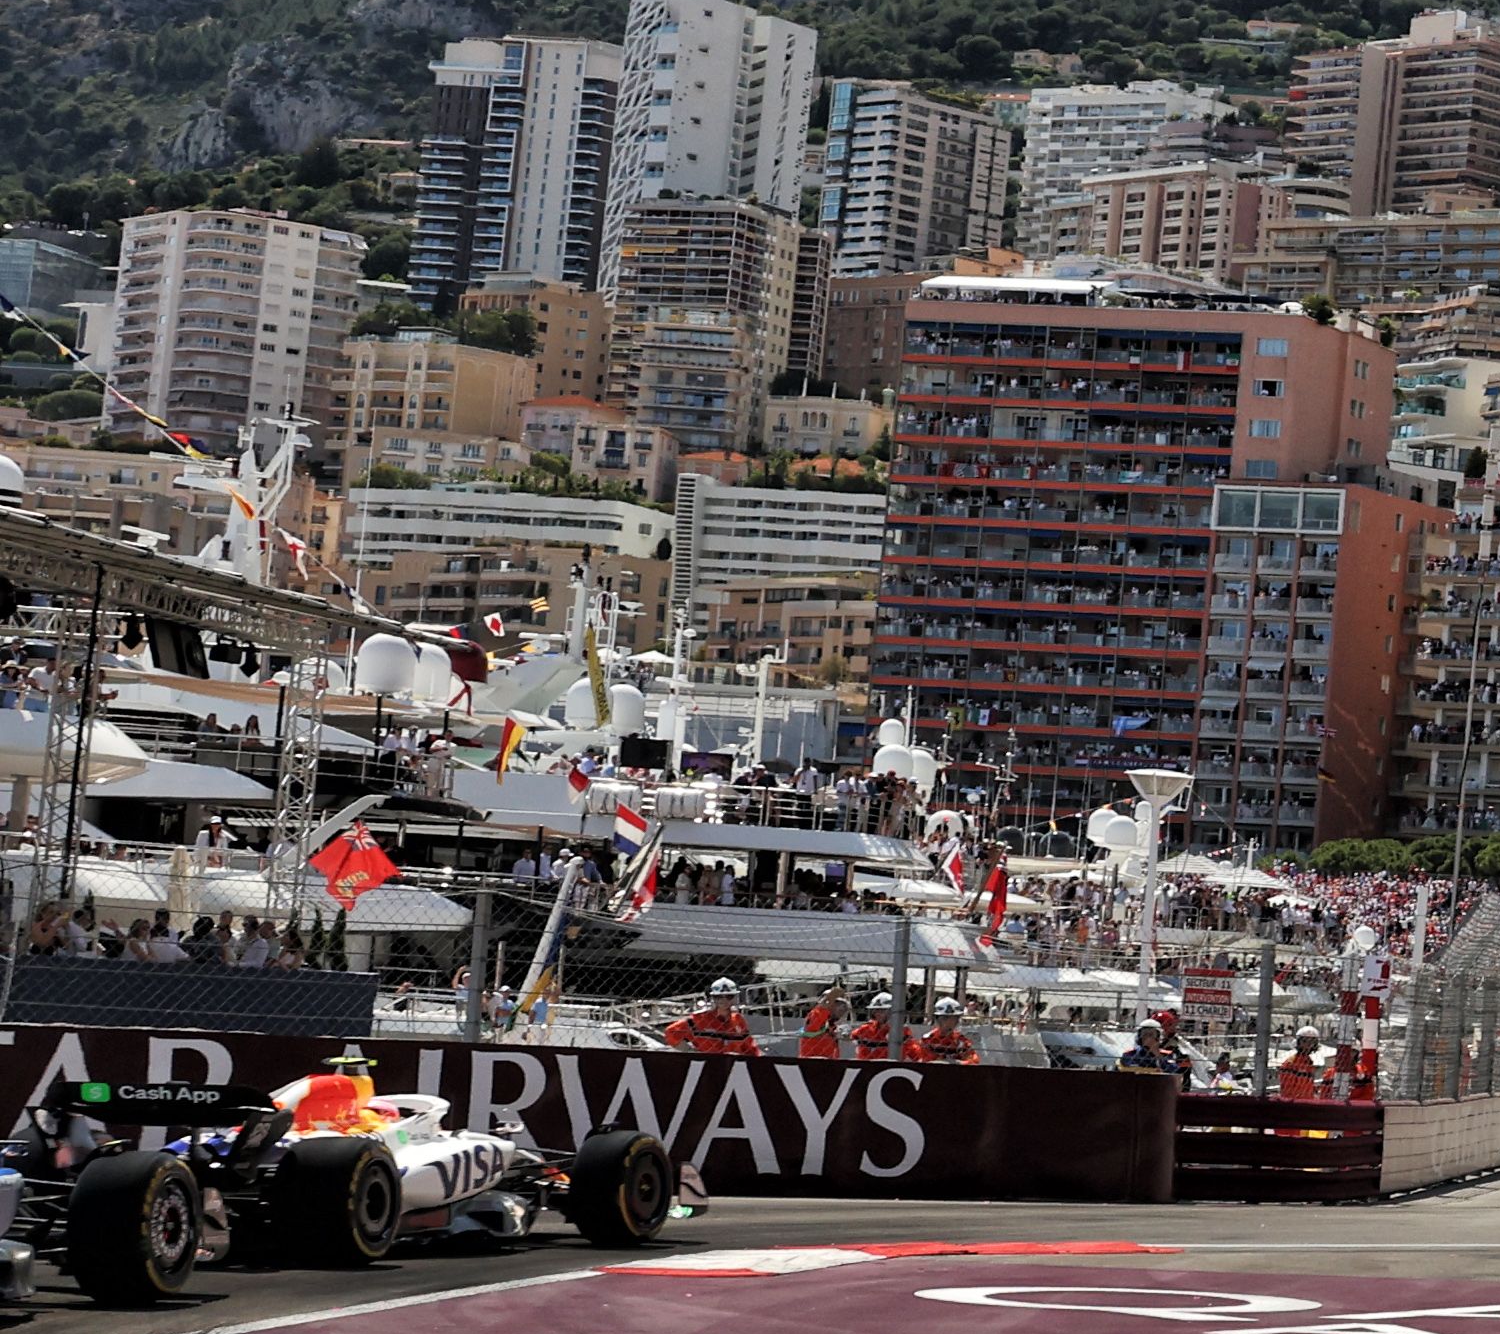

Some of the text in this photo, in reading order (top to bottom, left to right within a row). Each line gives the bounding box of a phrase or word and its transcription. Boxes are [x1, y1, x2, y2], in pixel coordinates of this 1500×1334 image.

[118, 1085, 220, 1105] Cash App
[424, 1143, 505, 1199] VISA
